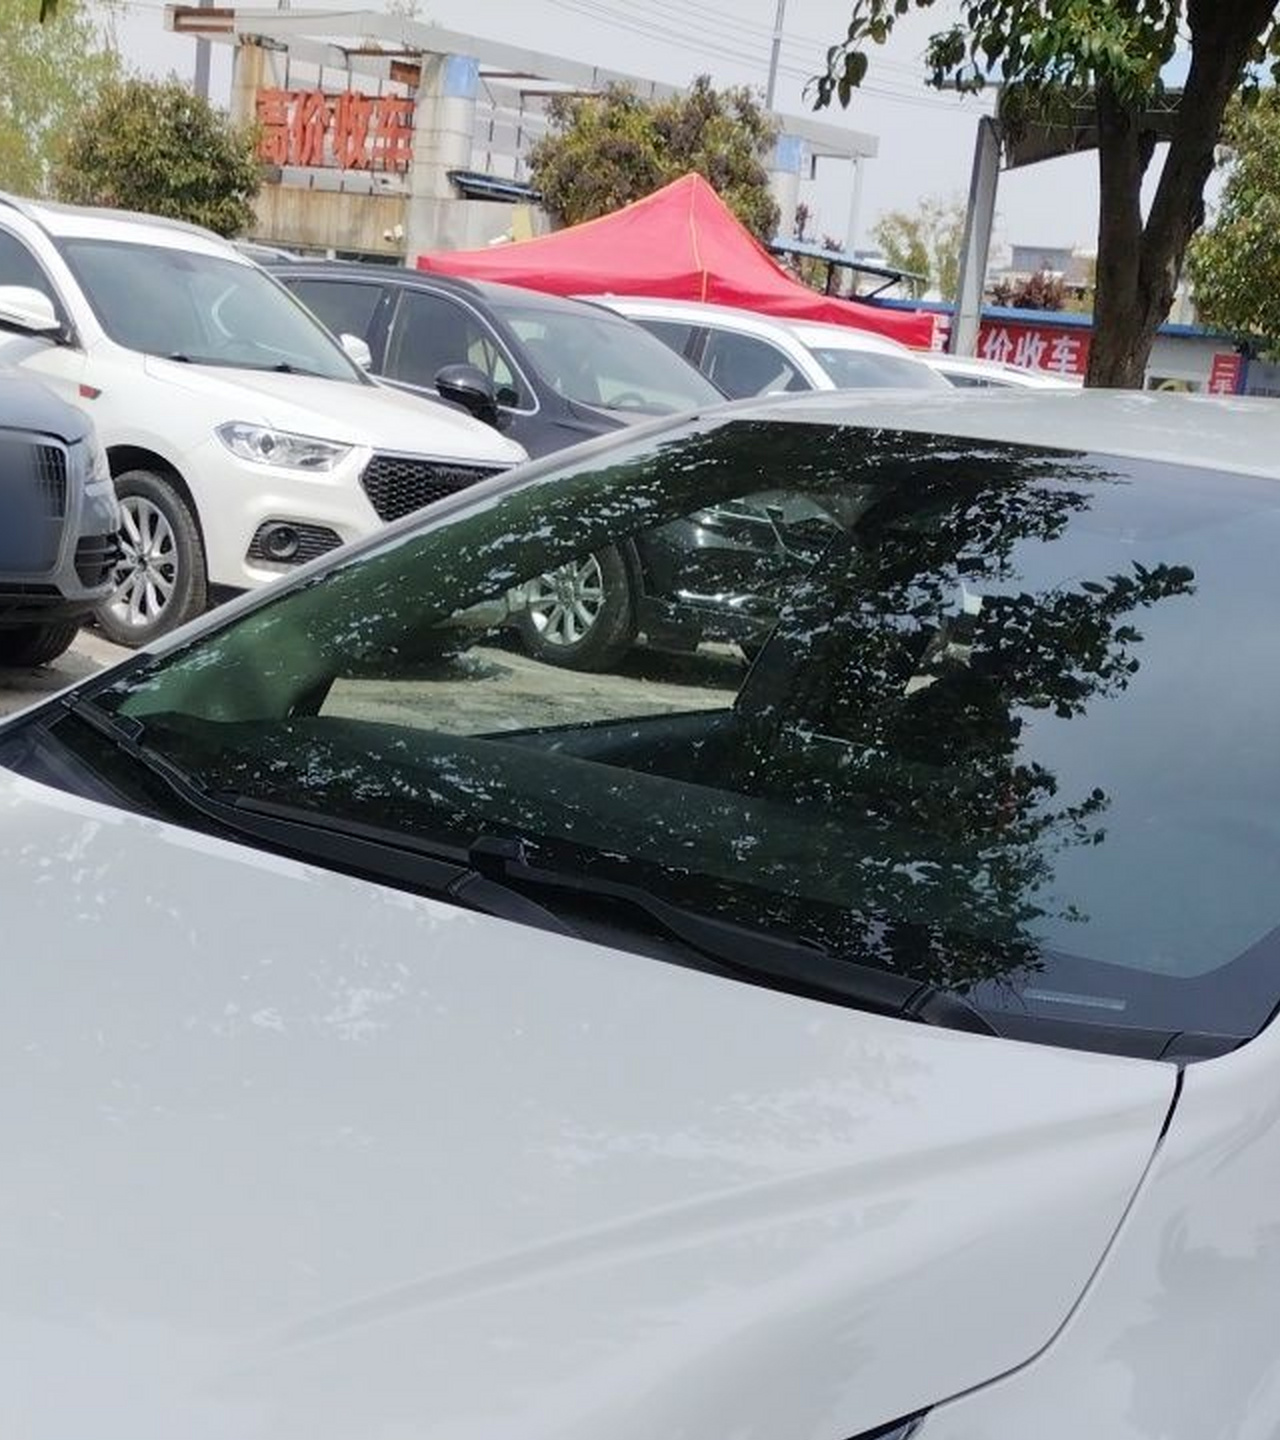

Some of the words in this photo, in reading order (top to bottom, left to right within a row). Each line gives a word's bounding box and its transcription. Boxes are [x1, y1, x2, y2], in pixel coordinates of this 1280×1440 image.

[256, 88, 416, 171] 高价收车
[975, 325, 1081, 374] 价收车
